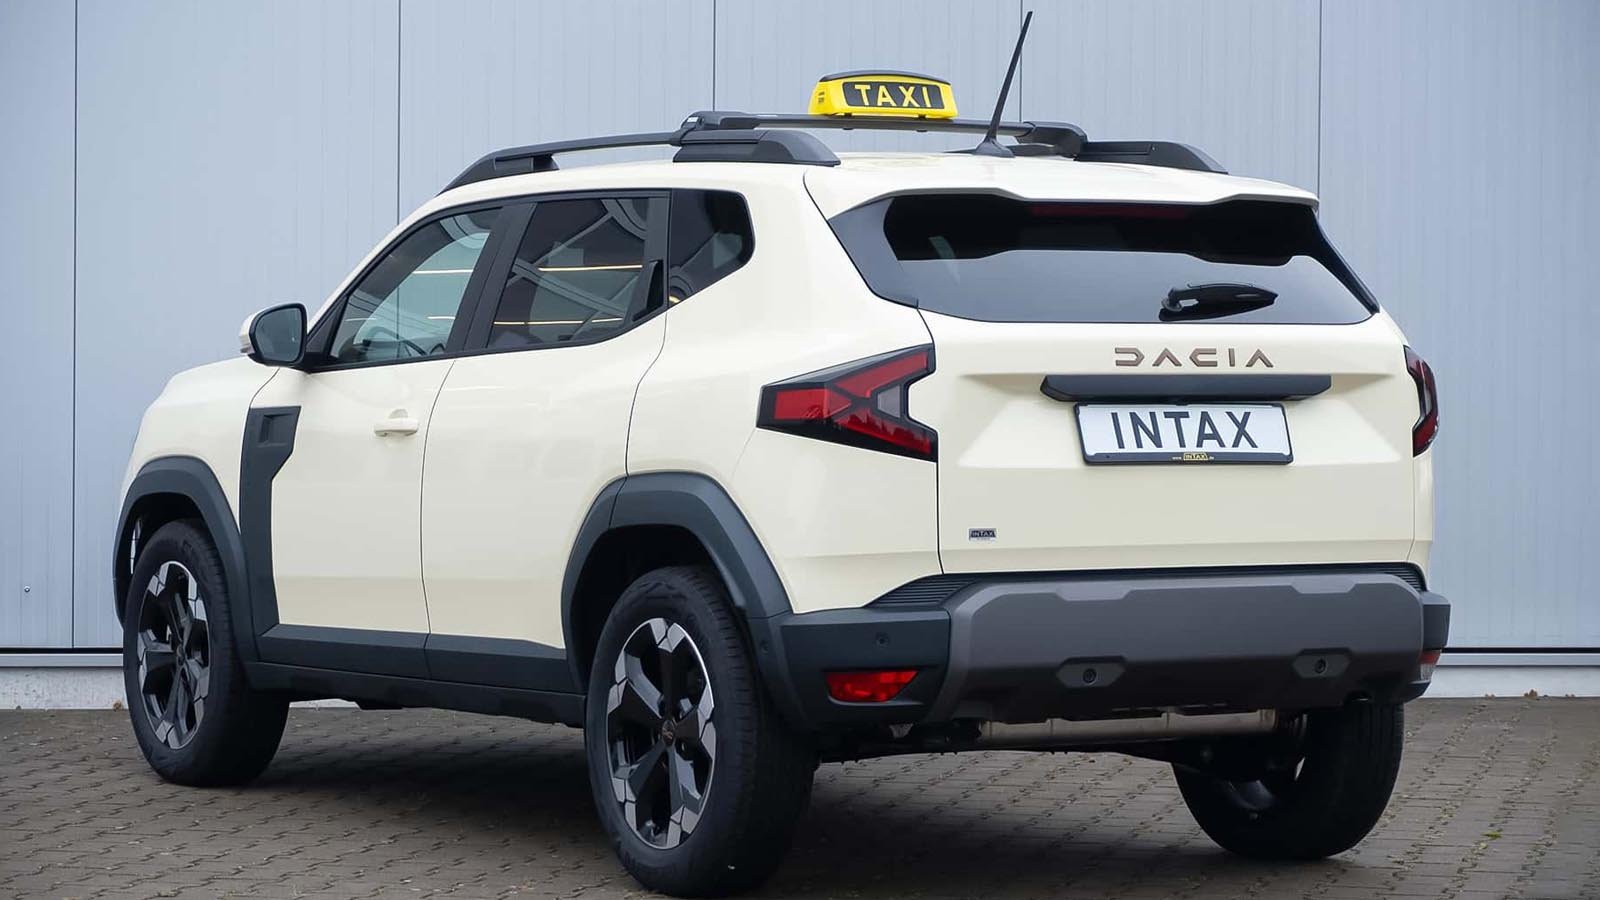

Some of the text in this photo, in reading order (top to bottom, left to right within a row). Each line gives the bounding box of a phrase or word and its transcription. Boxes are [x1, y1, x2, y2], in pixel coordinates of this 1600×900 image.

[854, 84, 932, 108] TAXI
[1115, 347, 1274, 368] DACIA
[1111, 411, 1259, 449] INTAX
